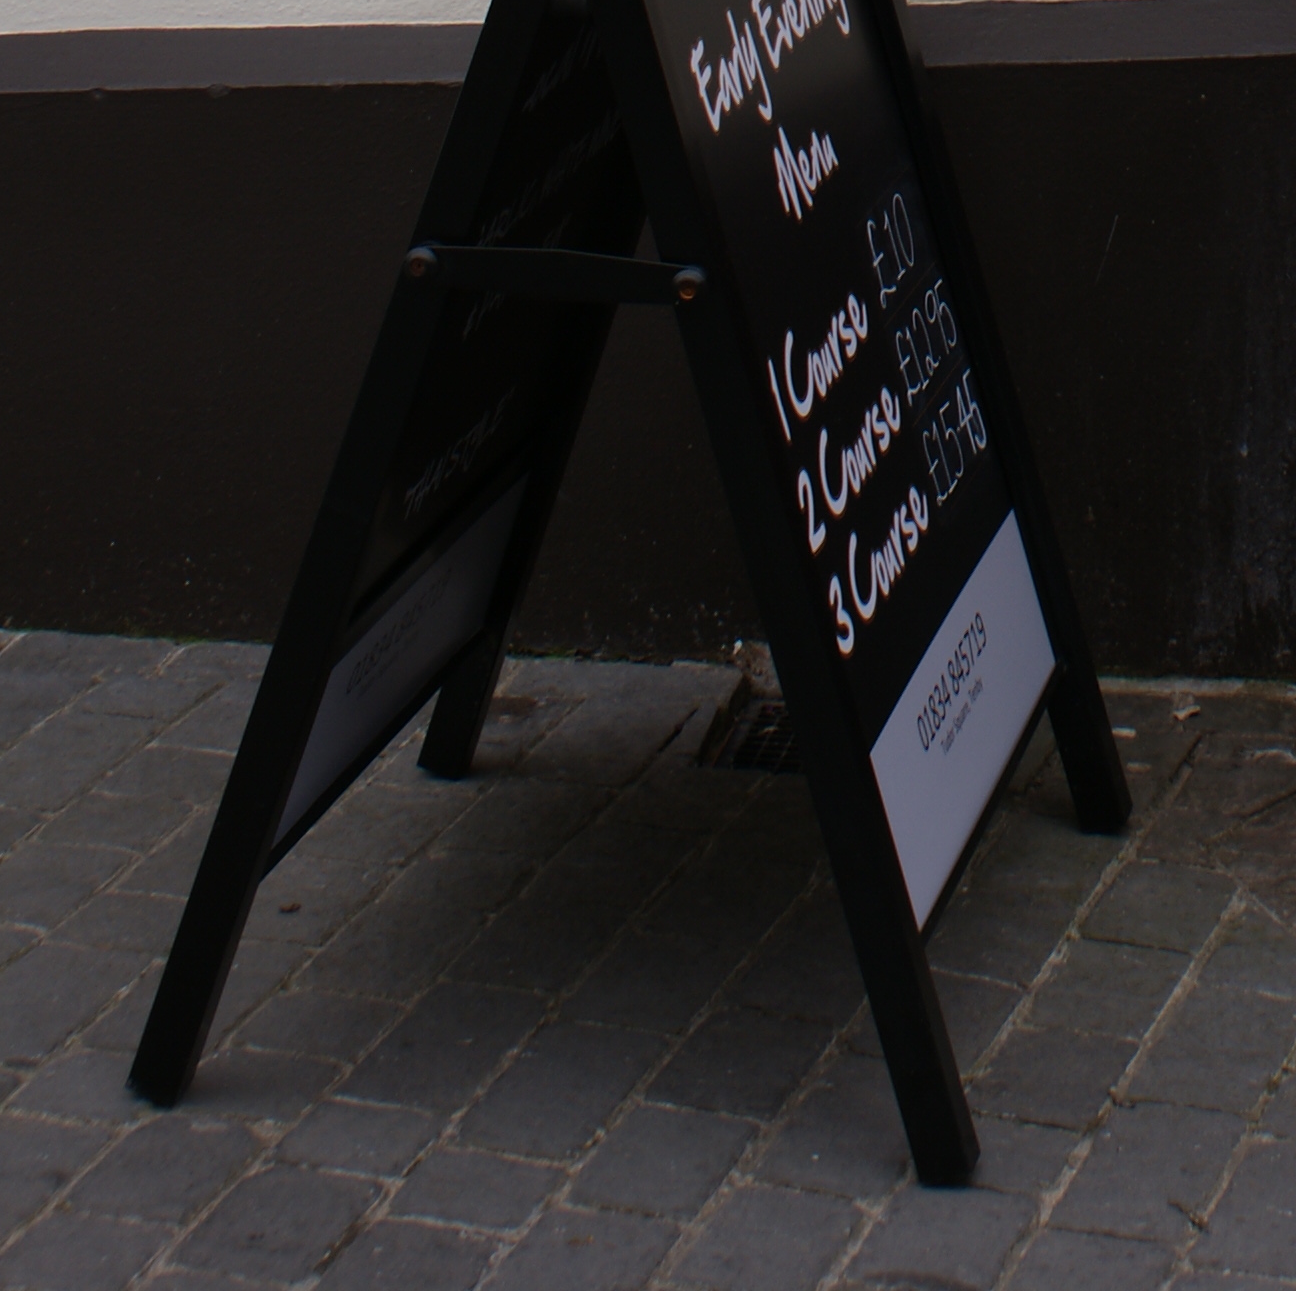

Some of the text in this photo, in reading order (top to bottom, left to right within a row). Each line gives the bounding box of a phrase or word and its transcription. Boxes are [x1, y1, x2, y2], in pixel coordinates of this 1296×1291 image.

[691, 9, 773, 133] Early
[774, 123, 839, 222] Menu
[766, 192, 917, 443] 1 Course £10
[797, 467, 828, 555] 2
[819, 384, 902, 519] Course
[828, 573, 855, 656] 3
[848, 483, 929, 622] Course
[917, 611, 987, 752] 01834 845719
